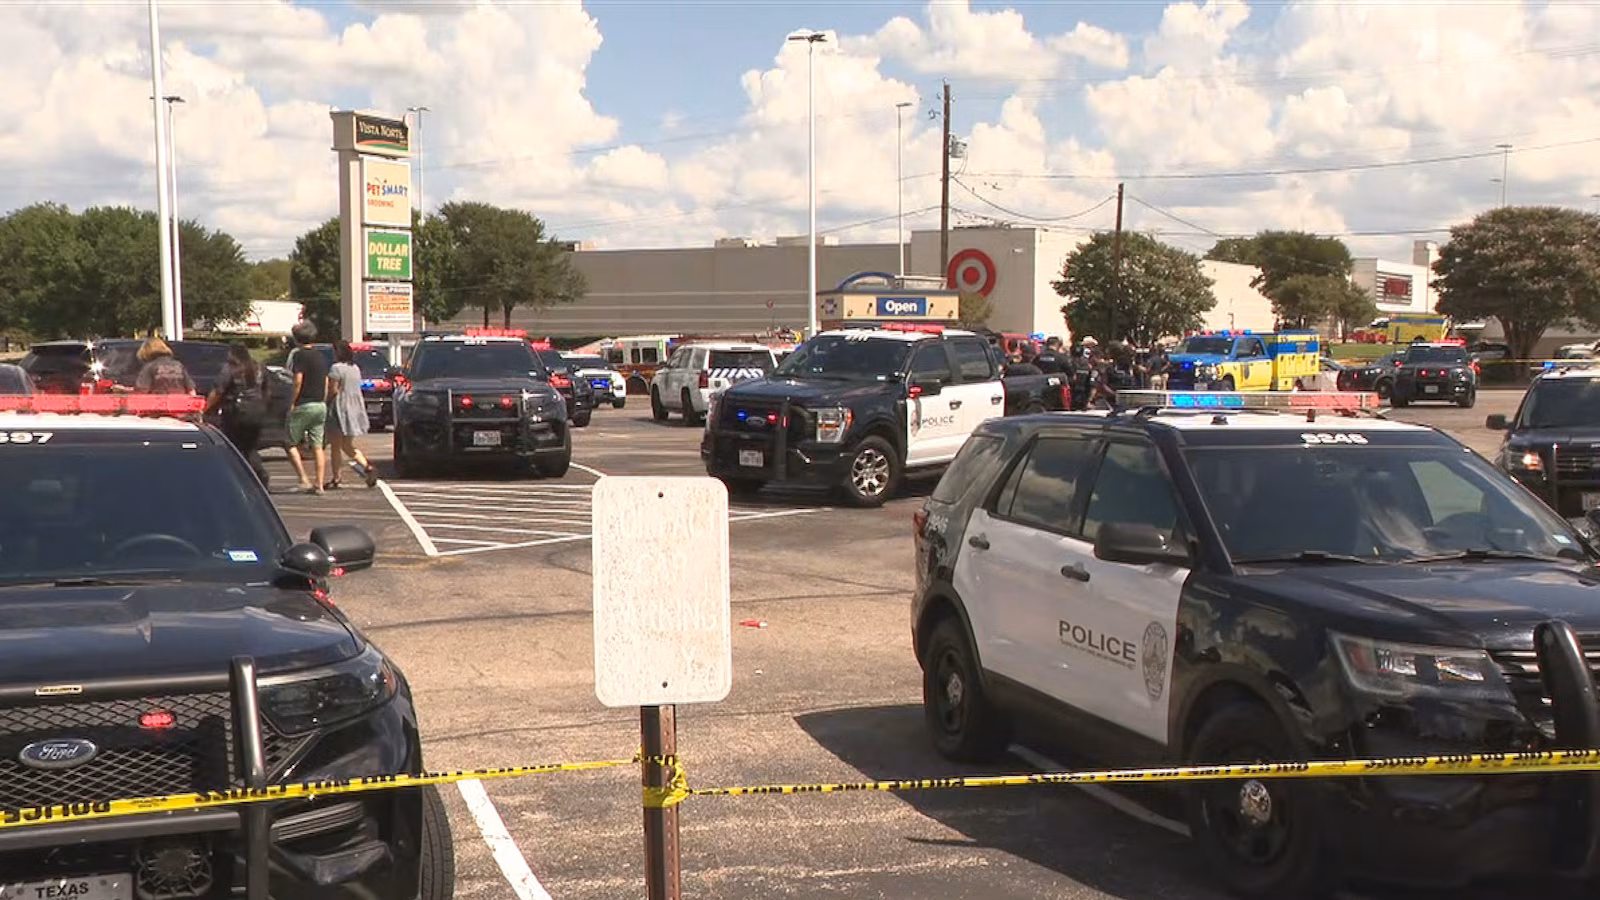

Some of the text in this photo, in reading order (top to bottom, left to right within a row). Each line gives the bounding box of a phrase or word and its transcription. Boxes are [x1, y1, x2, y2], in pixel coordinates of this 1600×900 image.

[368, 241, 408, 256] DOLLAR
[376, 257, 402, 271] TREE
[885, 300, 918, 315] Open
[1059, 619, 1137, 662] POLICE
[38, 743, 79, 760] Ford
[35, 882, 89, 899] TEXAS
